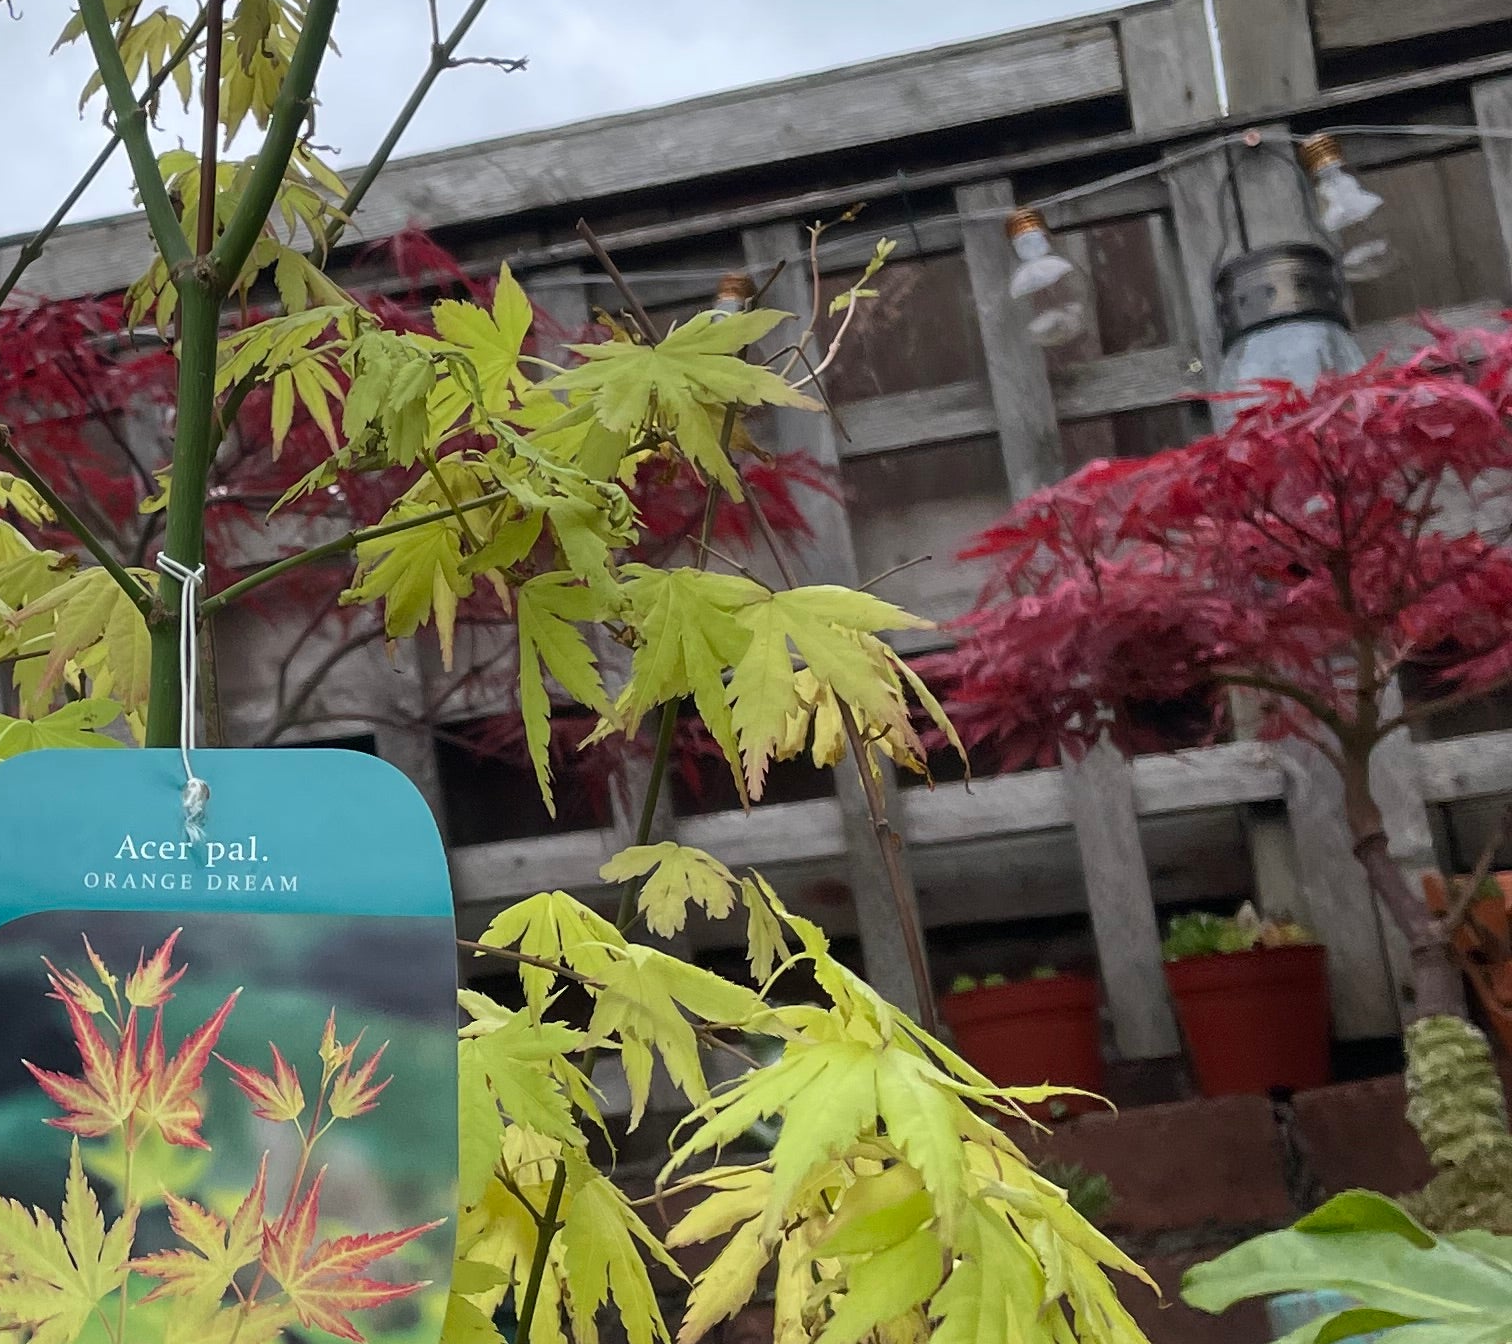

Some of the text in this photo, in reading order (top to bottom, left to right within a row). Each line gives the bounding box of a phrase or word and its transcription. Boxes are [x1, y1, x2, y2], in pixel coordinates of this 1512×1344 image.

[114, 834, 269, 867] Acer pal.
[84, 872, 298, 892] ORANGE DREAM
